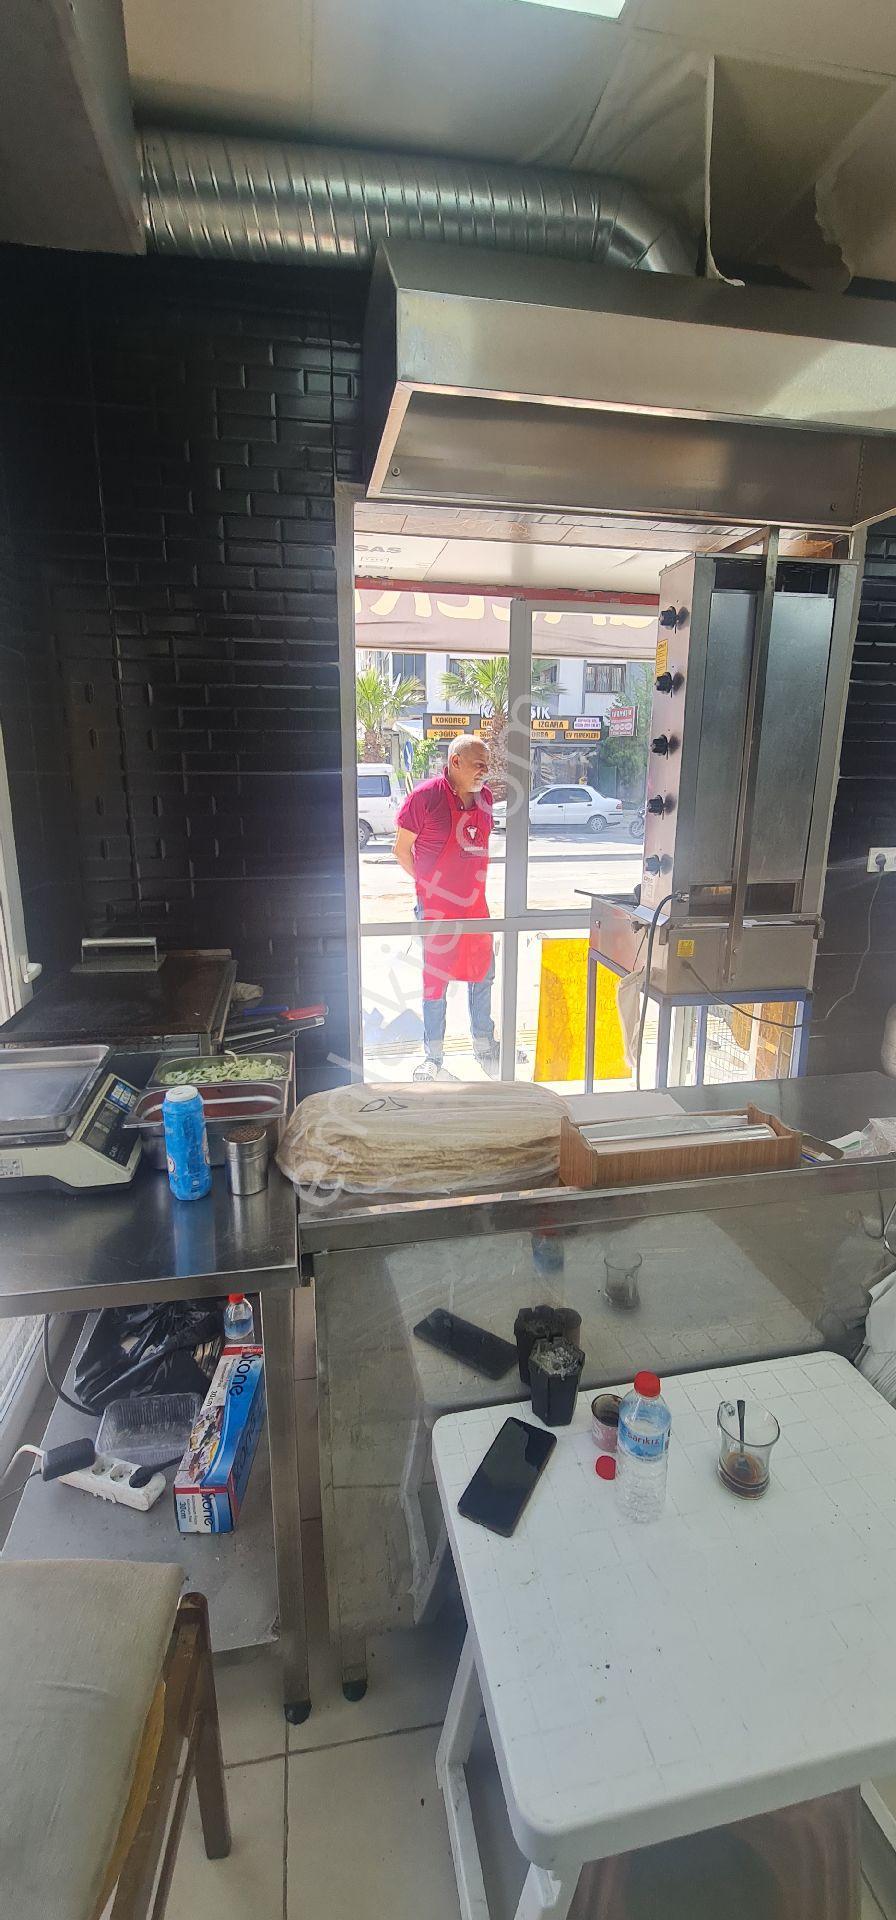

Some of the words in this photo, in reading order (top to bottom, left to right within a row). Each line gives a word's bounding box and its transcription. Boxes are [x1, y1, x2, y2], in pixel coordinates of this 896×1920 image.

[435, 716, 467, 725] KOKOREÇ
[231, 1353, 262, 1397] Stone
[201, 1493, 214, 1528] Stone
